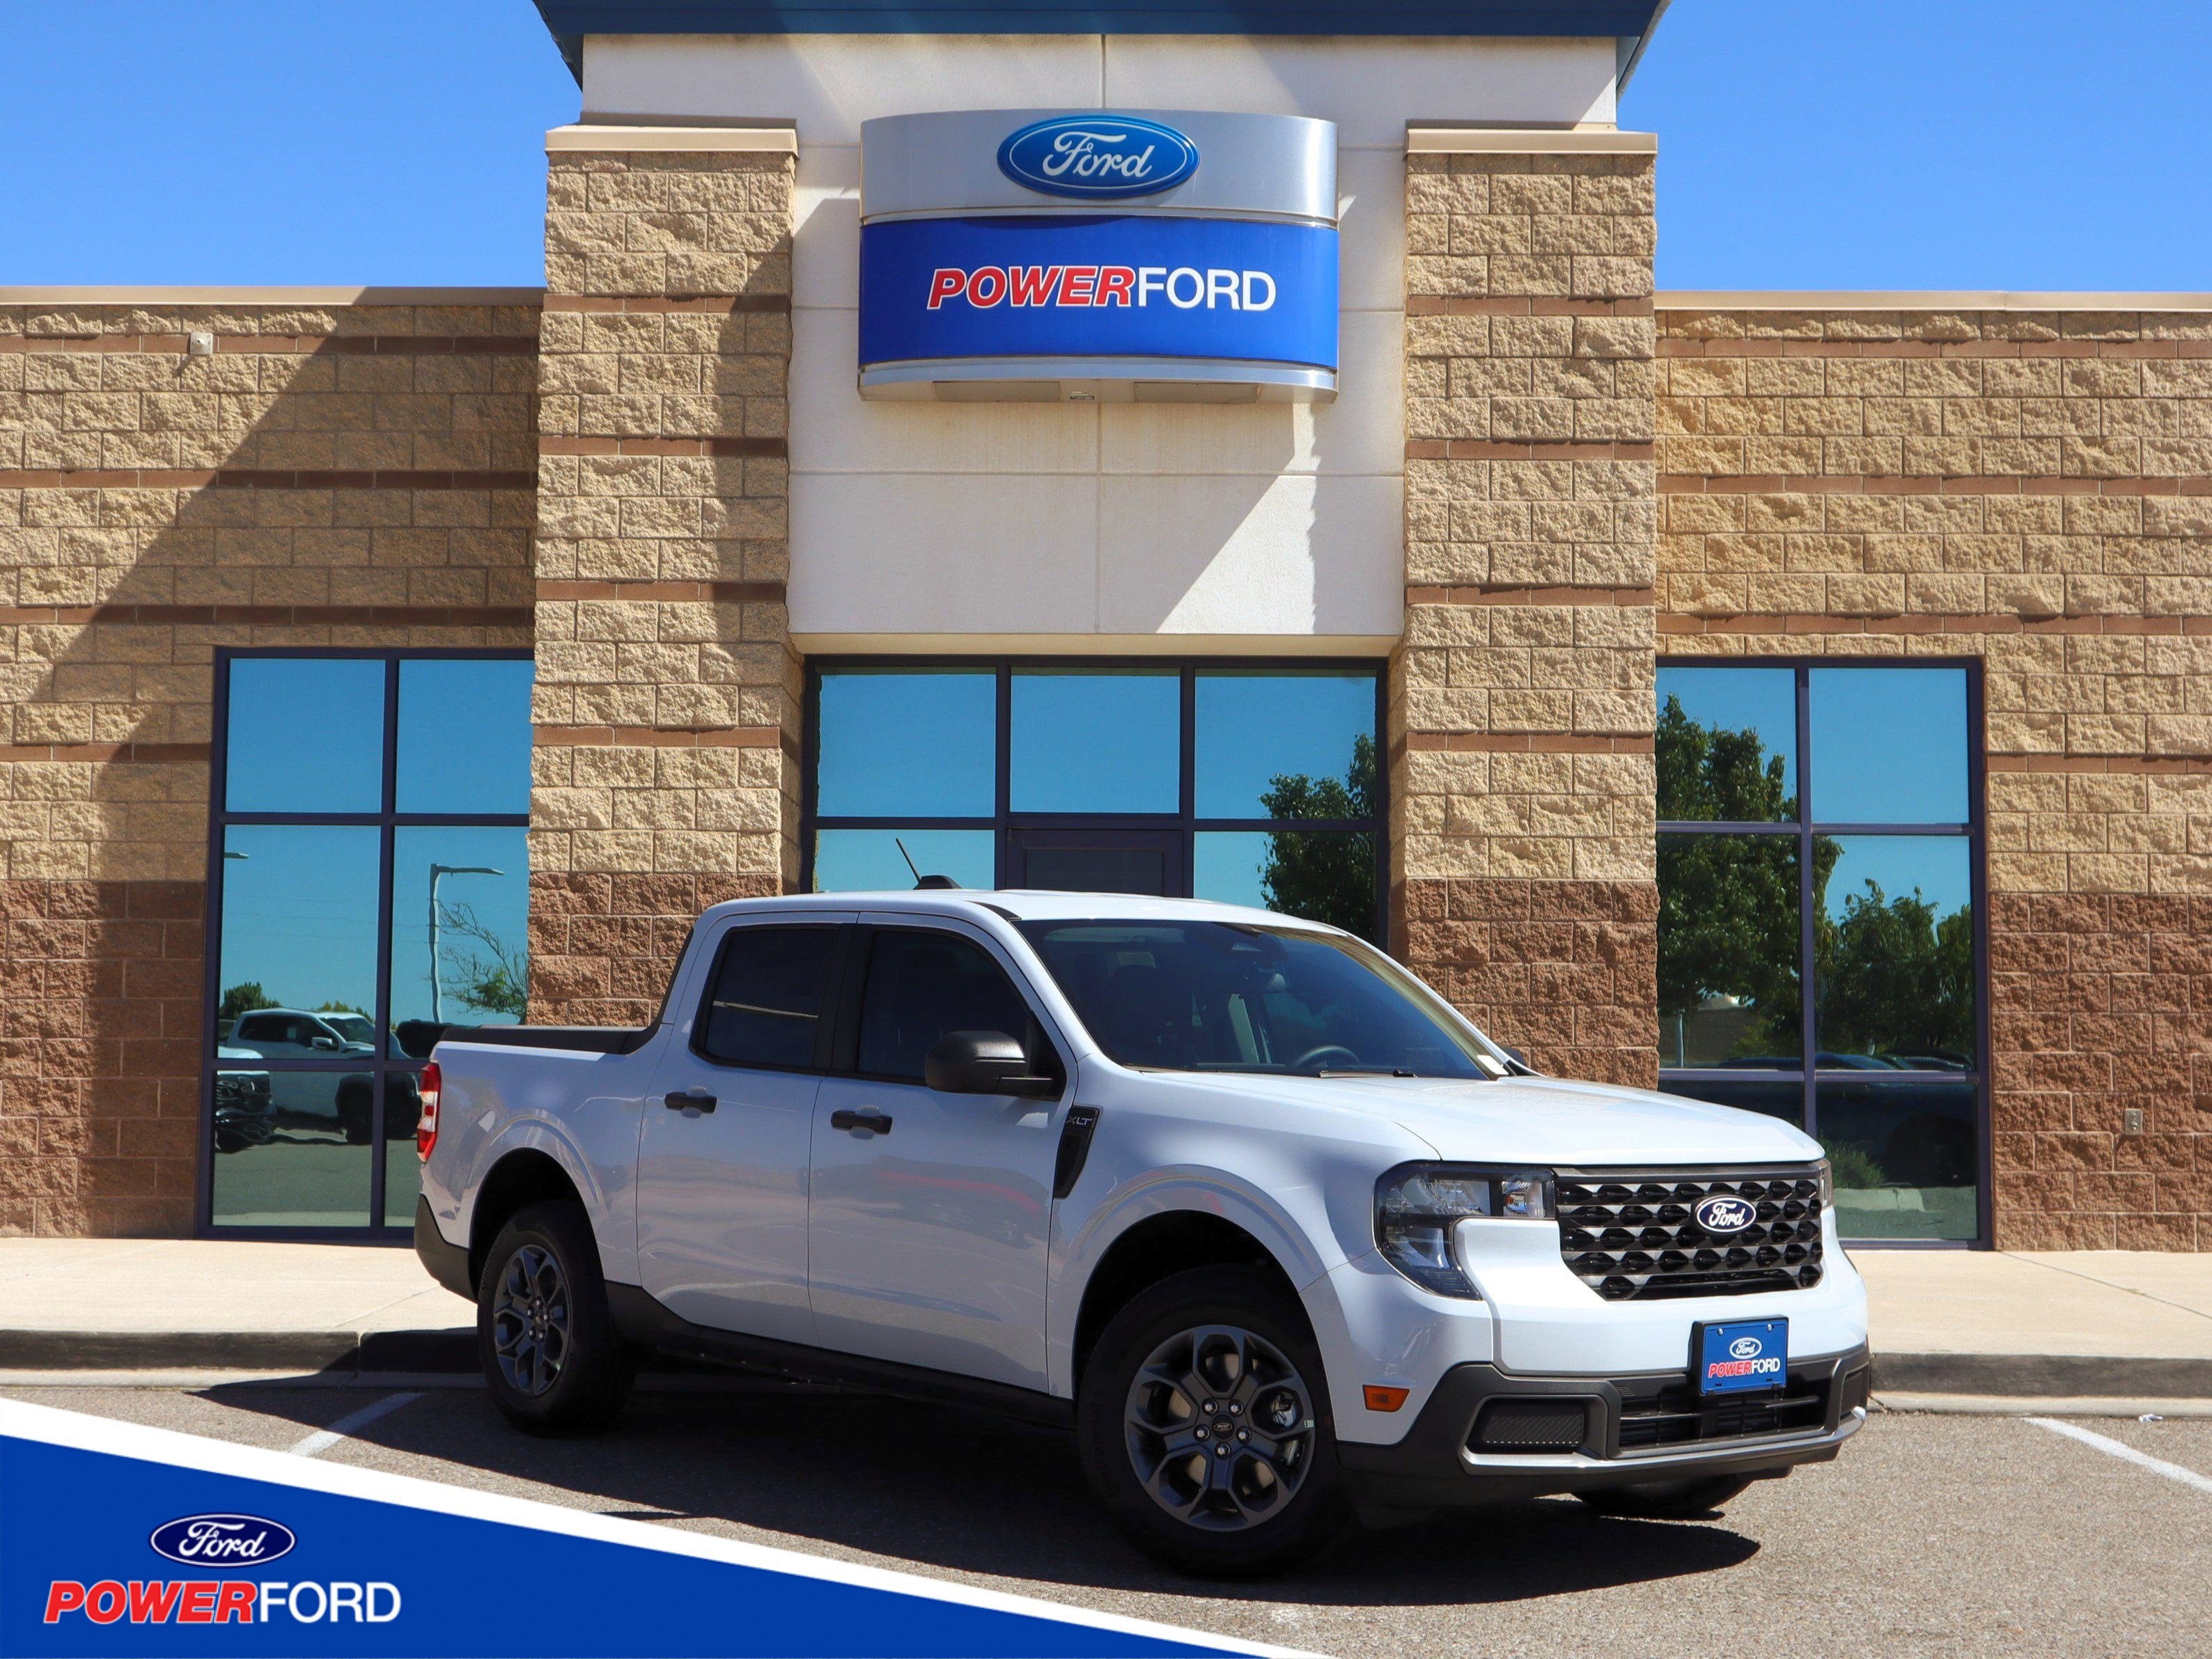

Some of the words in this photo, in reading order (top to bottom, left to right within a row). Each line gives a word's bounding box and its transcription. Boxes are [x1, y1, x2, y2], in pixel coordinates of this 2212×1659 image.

[1042, 130, 1153, 177] Ford
[926, 265, 1277, 311] POWERFORD
[1066, 1116, 1093, 1126] XLT
[1708, 1202, 1745, 1227] Ford
[1735, 1341, 1756, 1355] Ford
[1708, 1358, 1781, 1378] POWERFORD
